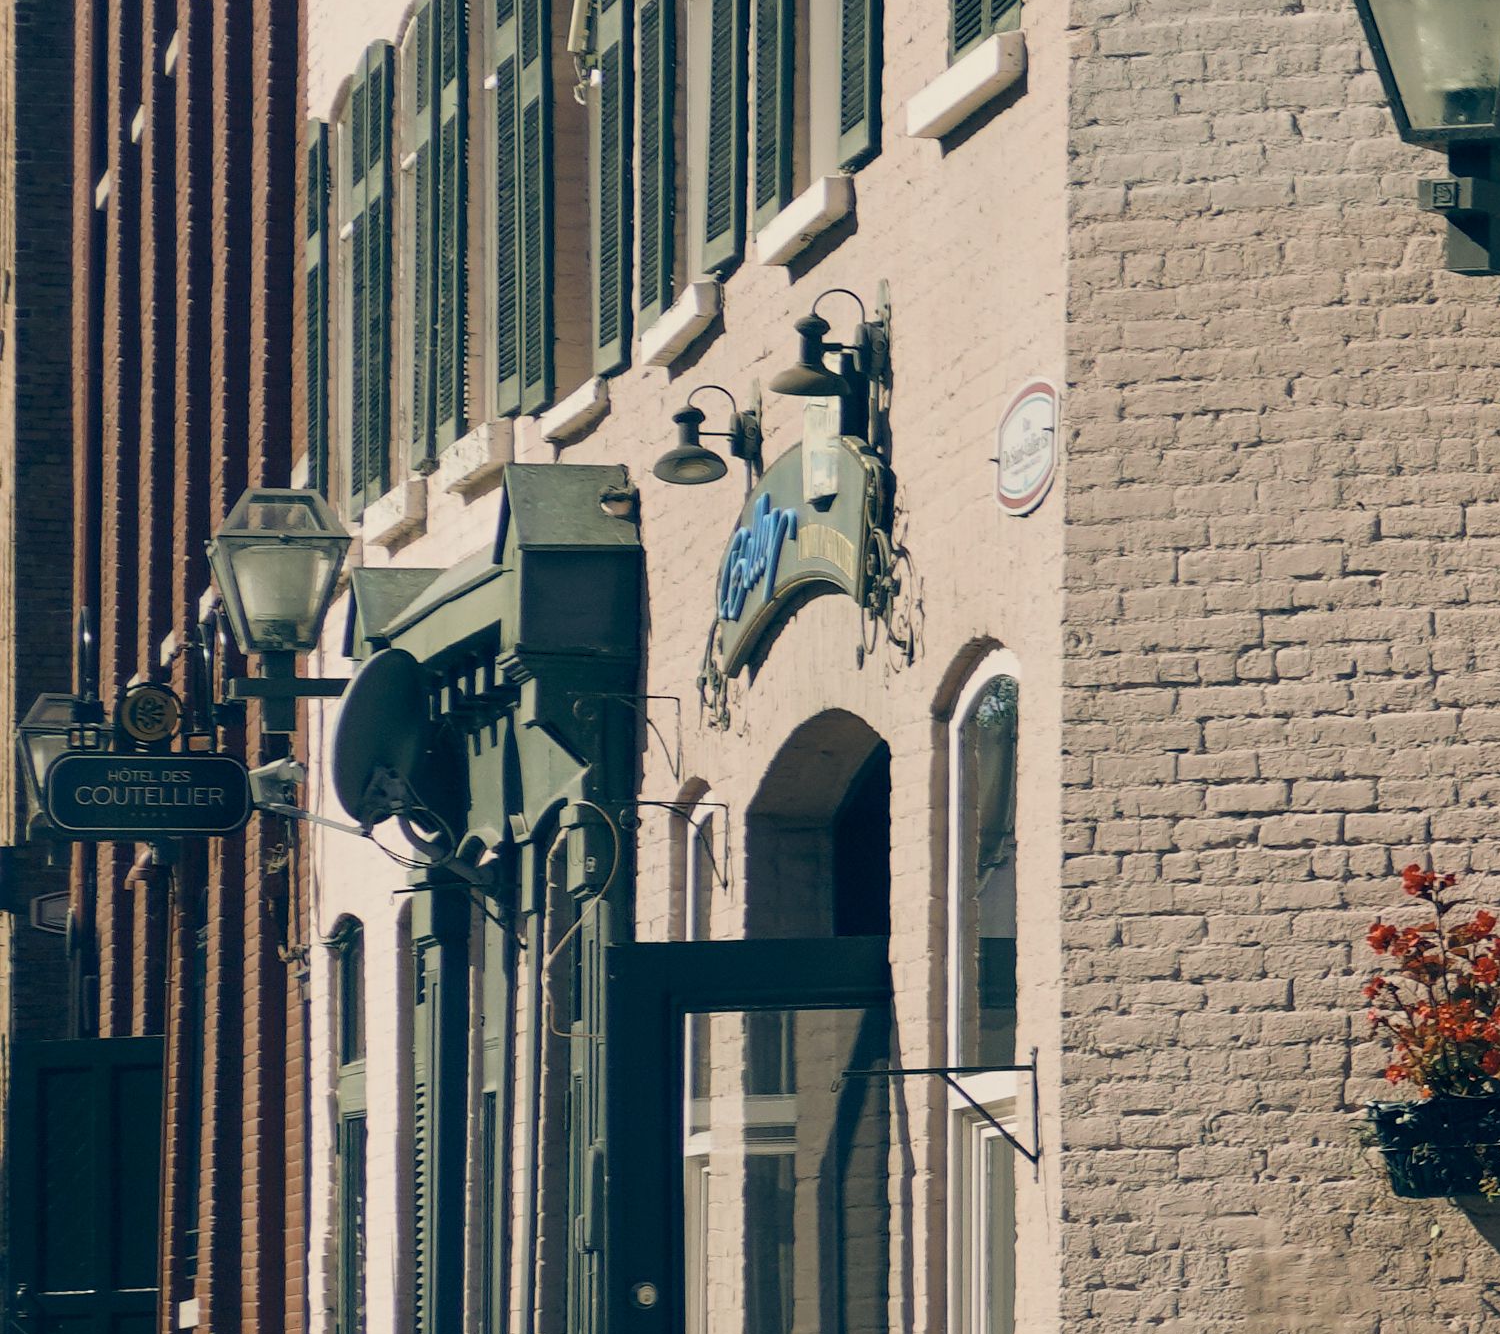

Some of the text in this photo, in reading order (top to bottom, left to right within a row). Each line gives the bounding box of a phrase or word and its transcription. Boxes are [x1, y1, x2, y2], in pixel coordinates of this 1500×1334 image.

[107, 767, 192, 783] HÔTEL DES
[74, 785, 225, 806] COUTELLIER
